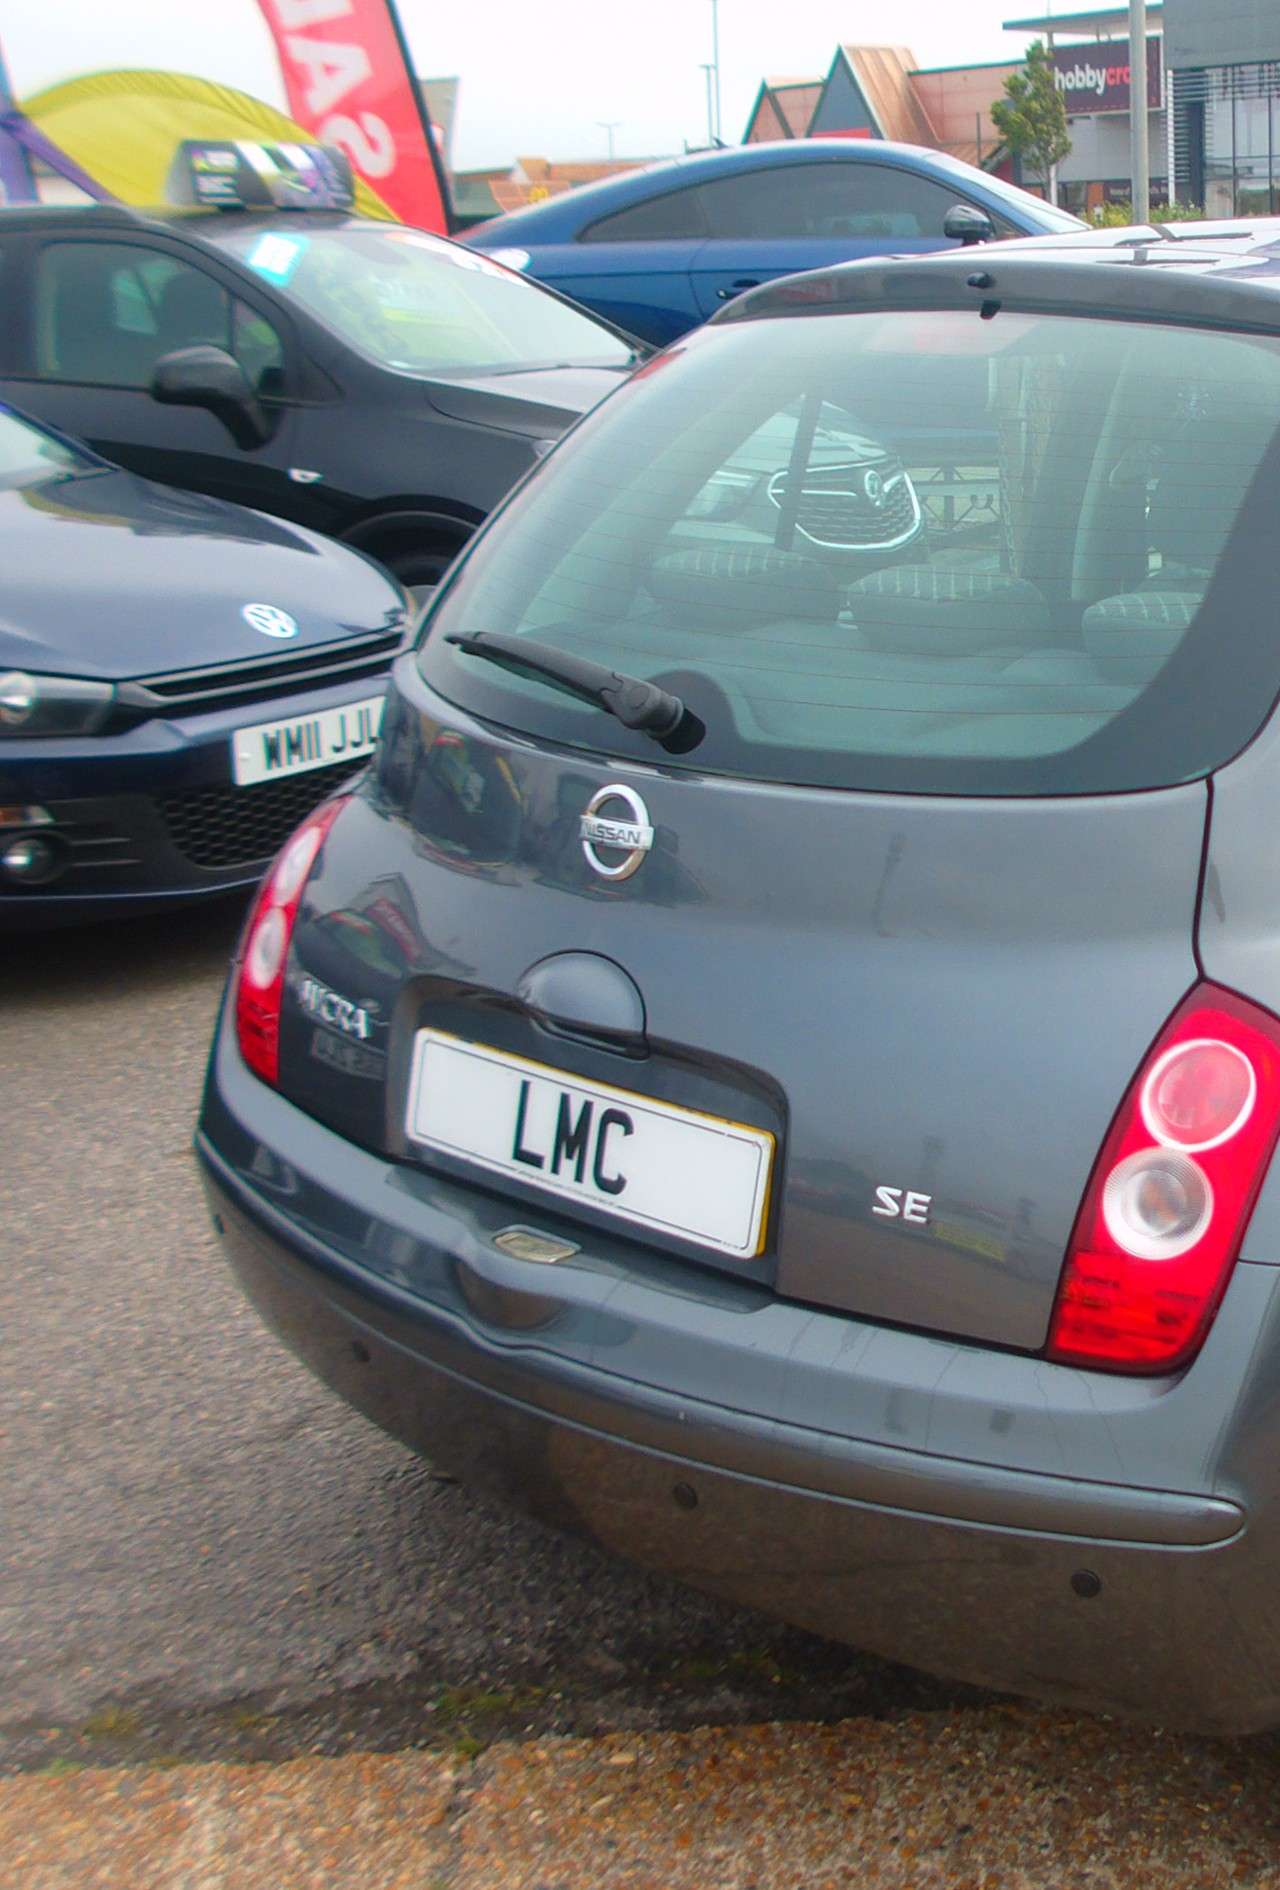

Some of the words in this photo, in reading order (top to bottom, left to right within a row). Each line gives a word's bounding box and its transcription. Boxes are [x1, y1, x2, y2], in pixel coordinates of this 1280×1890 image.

[581, 819, 641, 846] NISSAN
[512, 1079, 634, 1196] LMC
[872, 1186, 932, 1224] SE
